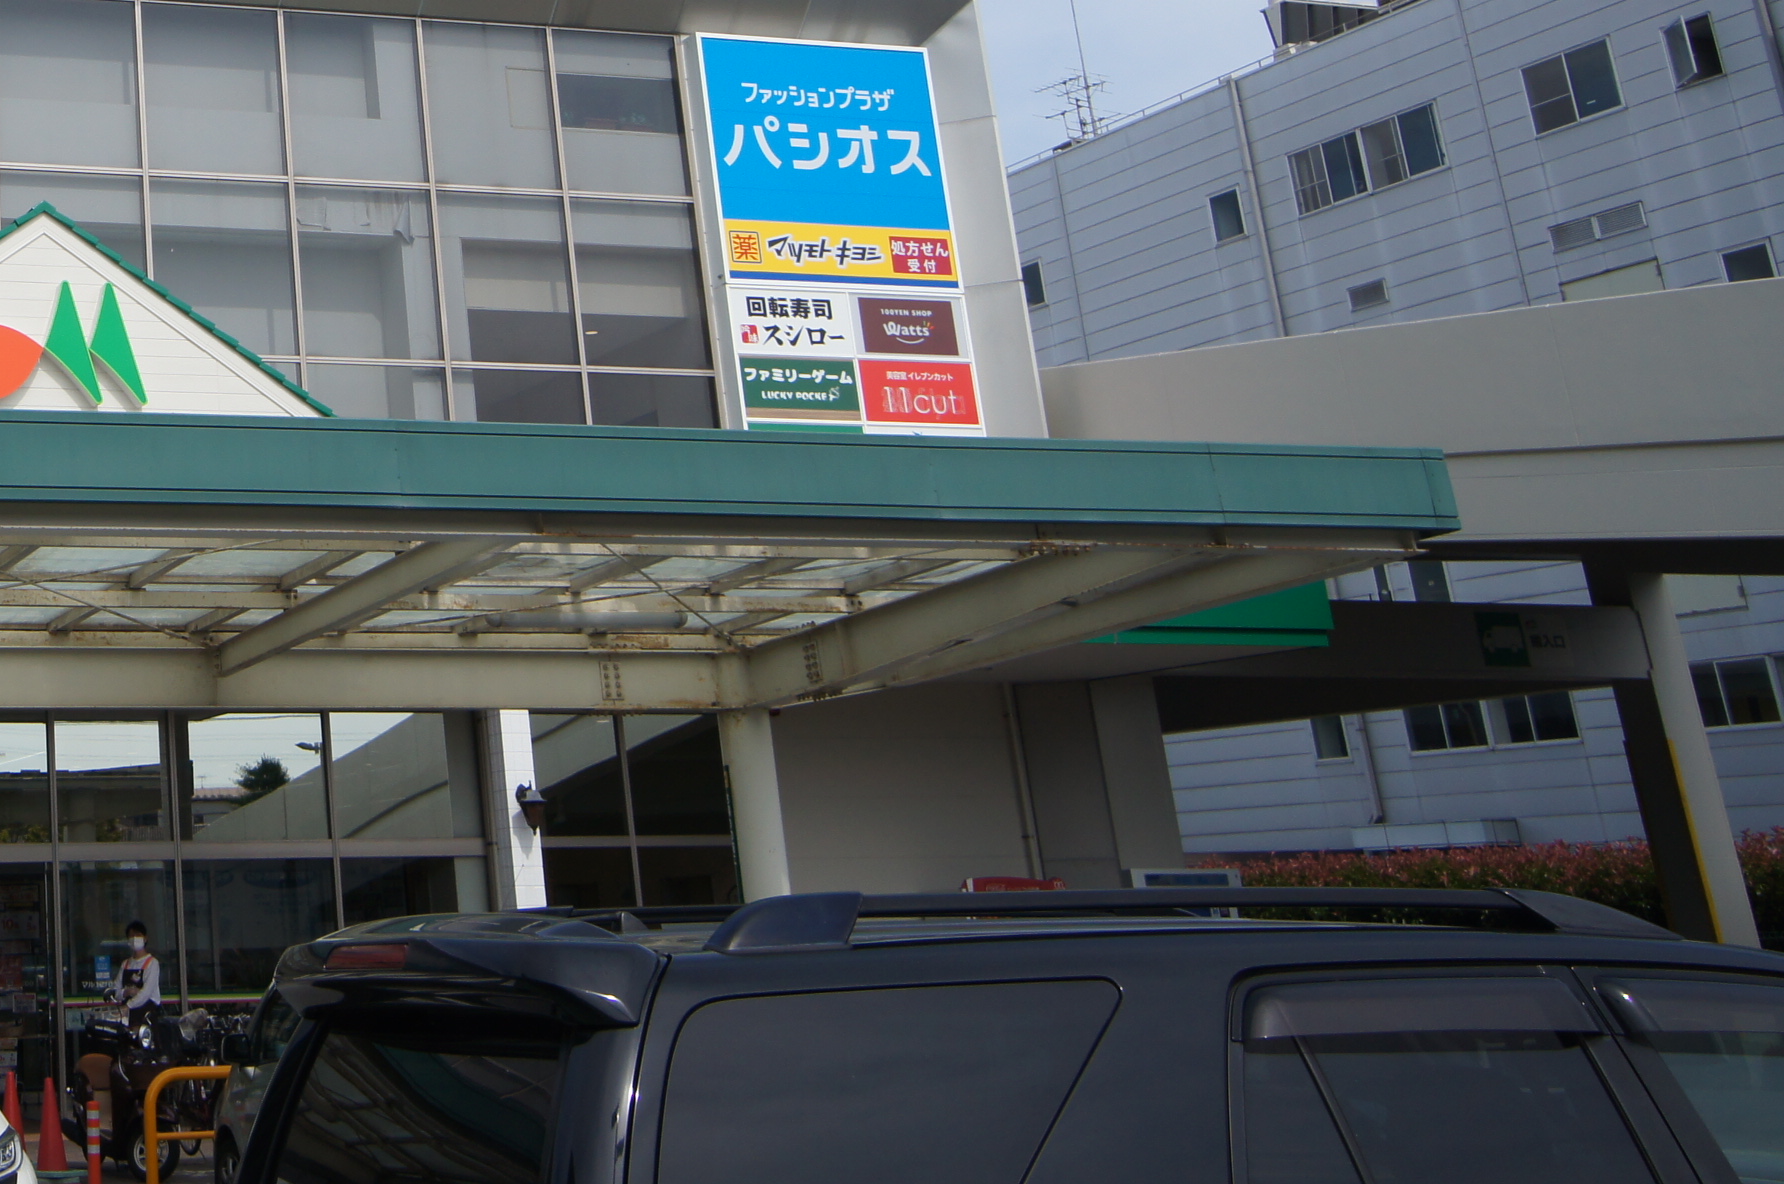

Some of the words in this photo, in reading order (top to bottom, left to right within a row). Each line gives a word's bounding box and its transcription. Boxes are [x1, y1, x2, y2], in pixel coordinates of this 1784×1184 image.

[740, 82, 895, 111] ファッションプラザ
[723, 115, 933, 177] パシオス
[732, 233, 759, 262] 薬
[890, 239, 950, 258] 処方せん
[907, 259, 937, 274] 受付
[745, 296, 833, 320] 回転寿司
[911, 309, 933, 317] SHOP
[762, 324, 846, 346] スシロー
[882, 320, 931, 337] Watts
[743, 367, 854, 385] ファミリーゲーム
[908, 371, 954, 382] イレブンカット
[761, 390, 794, 400] LUCKY
